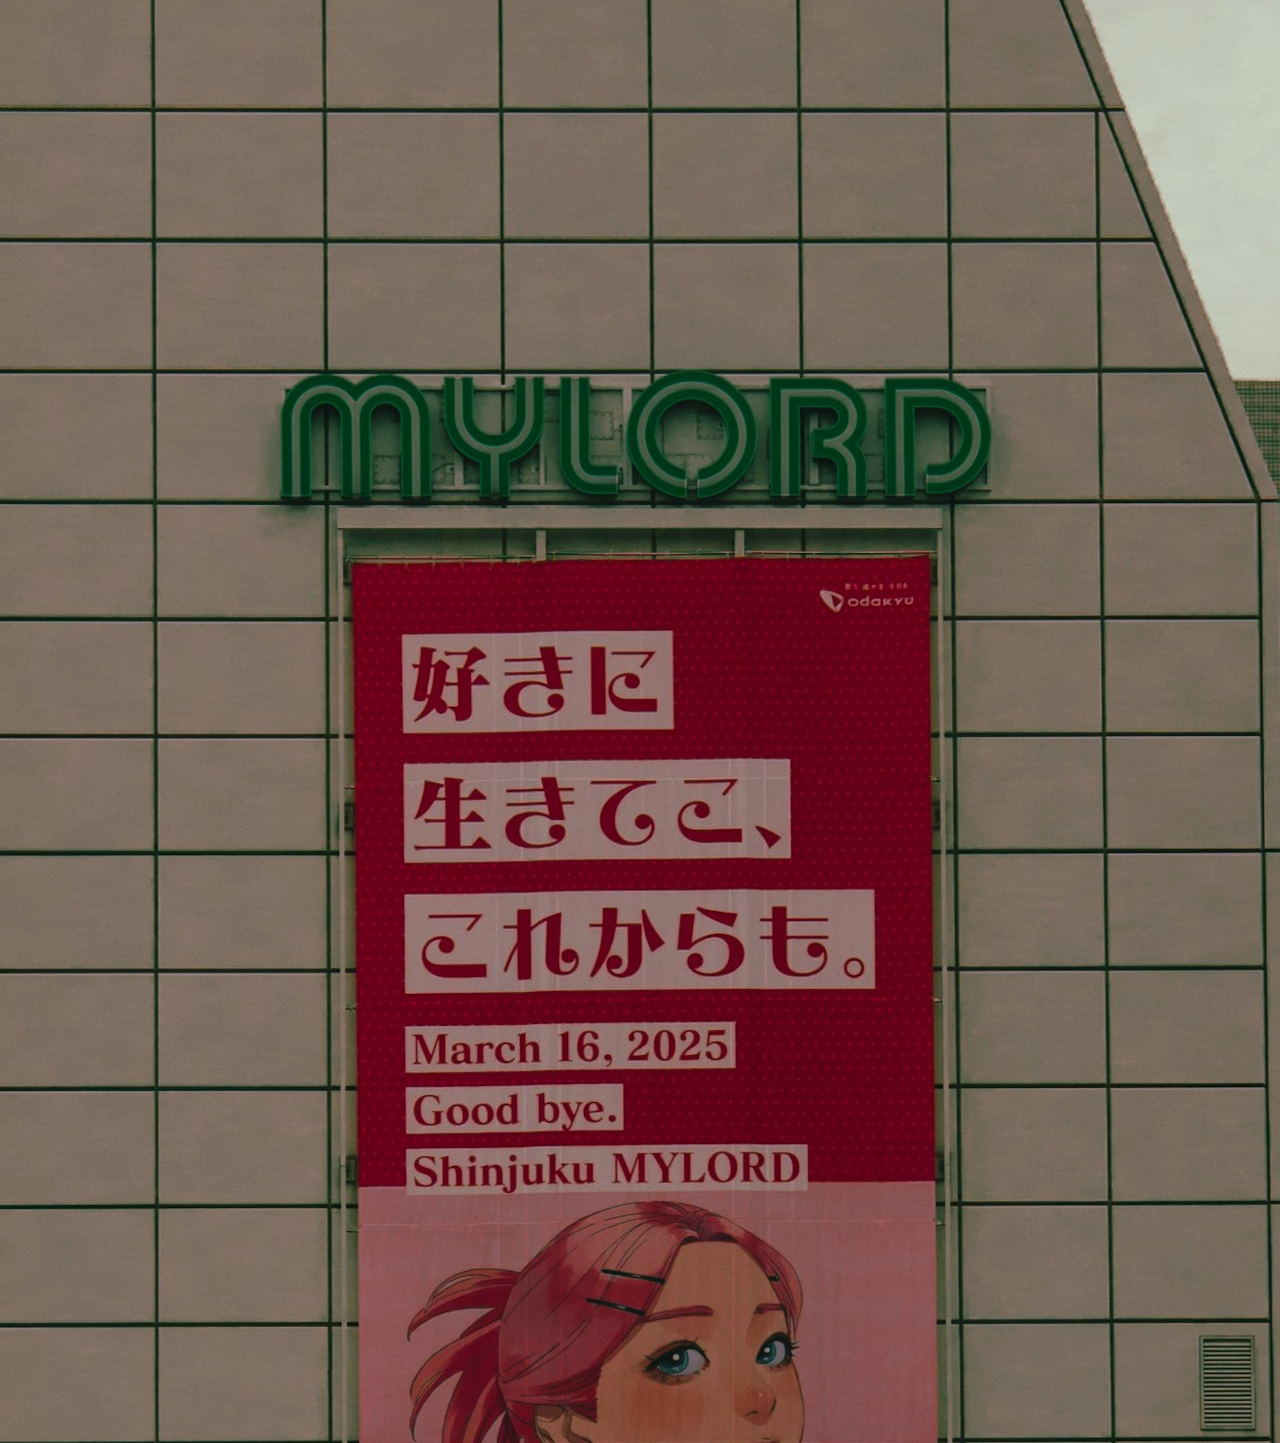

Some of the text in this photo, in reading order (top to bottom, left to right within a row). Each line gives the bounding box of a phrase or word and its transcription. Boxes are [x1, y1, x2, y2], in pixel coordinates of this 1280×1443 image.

[279, 370, 992, 500] MYLORD
[410, 644, 660, 722] 好きに
[413, 775, 782, 854] 生きてこ、
[421, 905, 868, 980] これからも。
[411, 1027, 729, 1071] March 16, 2025
[411, 1089, 617, 1131] Good bye.
[411, 1150, 802, 1195] Shinjuku MYLORD
